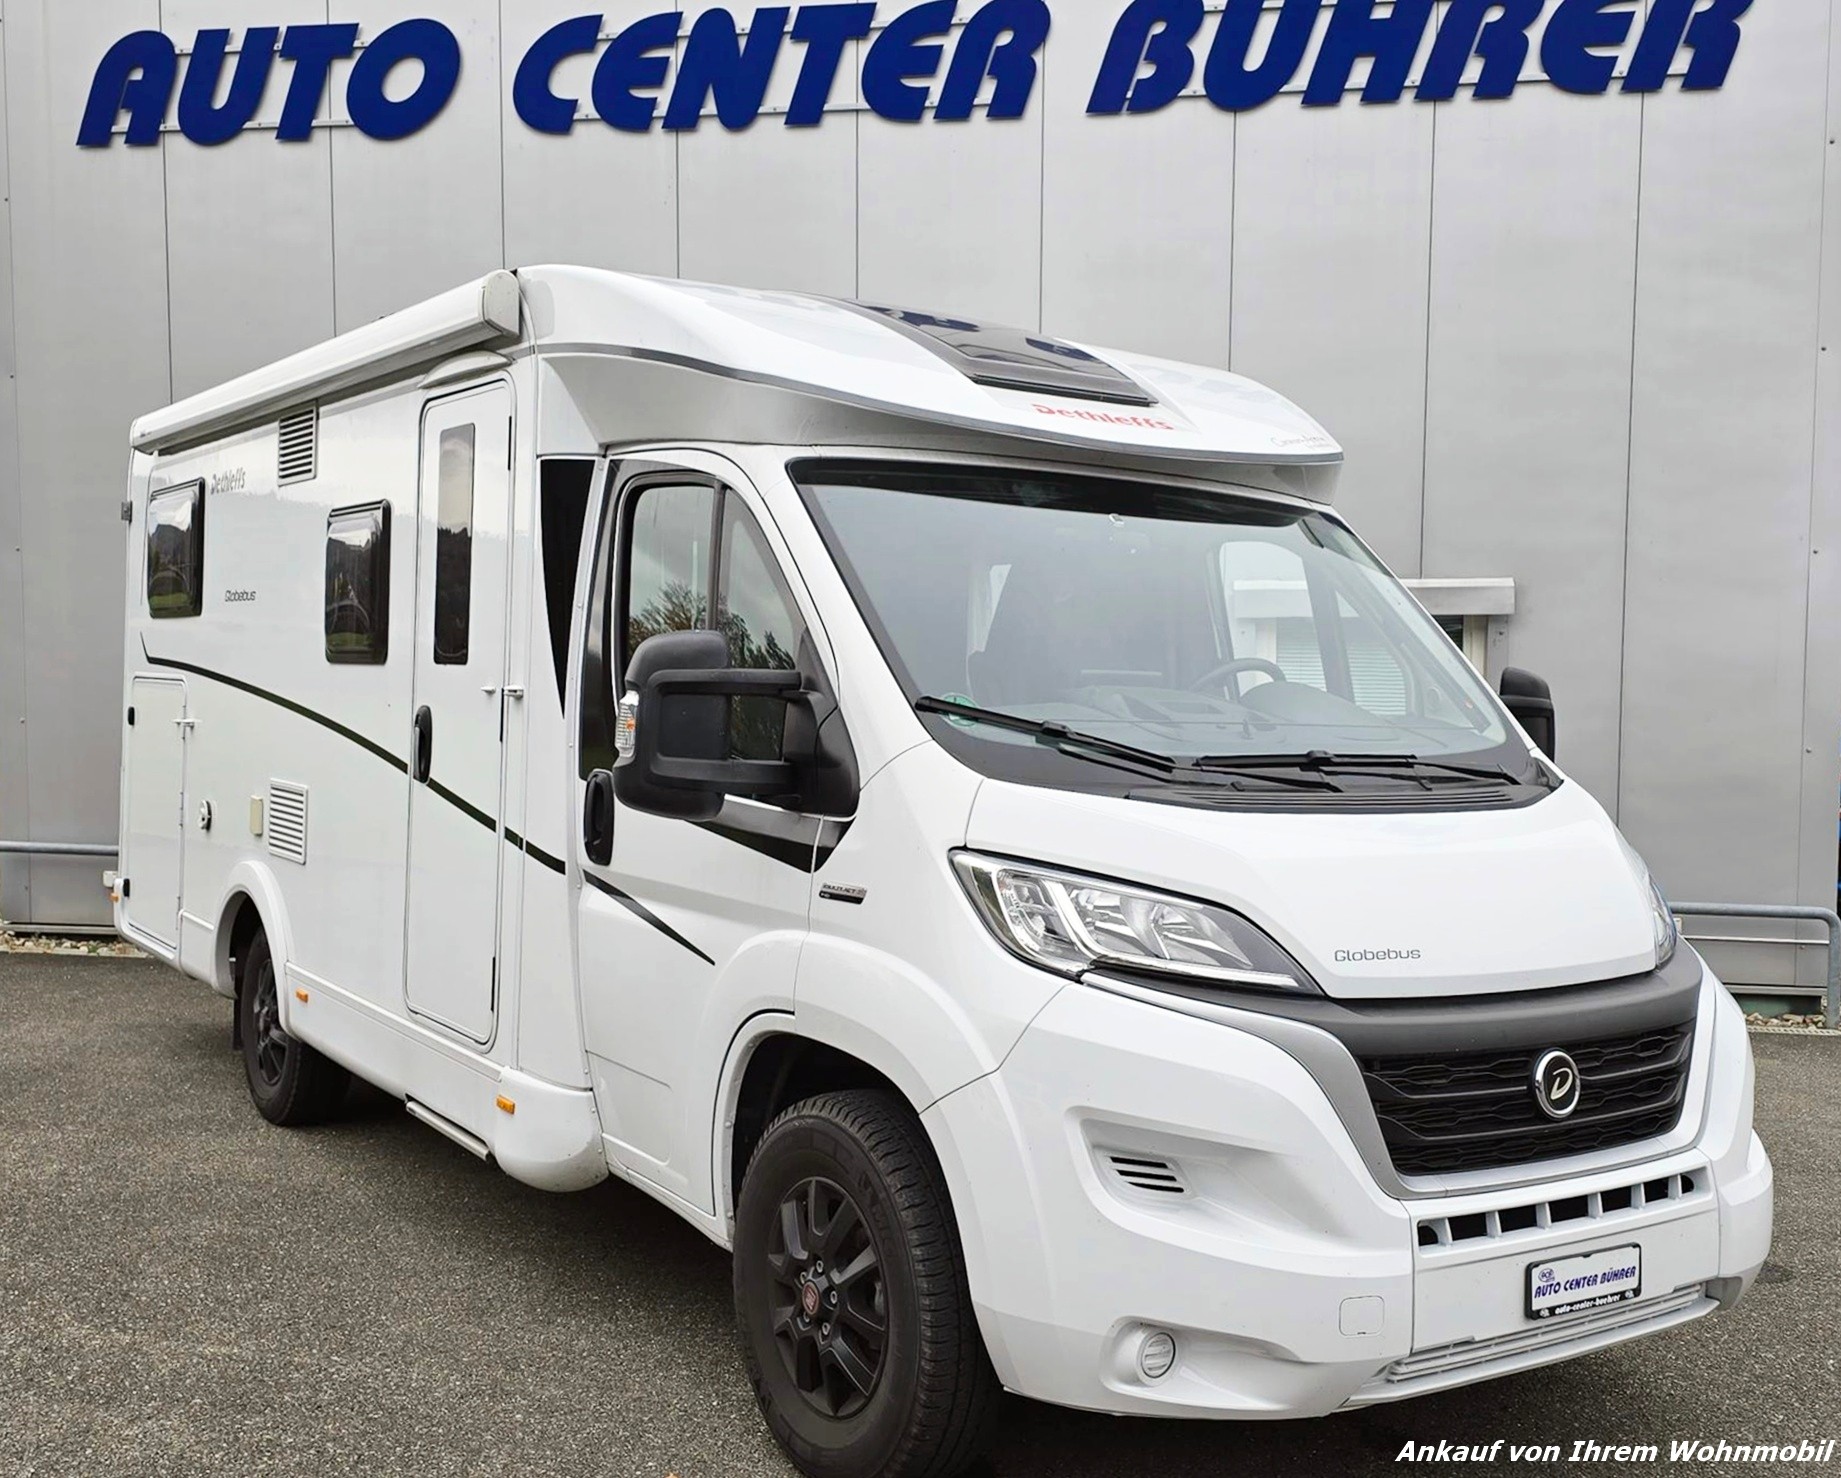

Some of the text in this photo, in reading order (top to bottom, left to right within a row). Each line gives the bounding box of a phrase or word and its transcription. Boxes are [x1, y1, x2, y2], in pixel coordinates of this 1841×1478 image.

[77, 18, 460, 146] AUTO
[513, 0, 1050, 133] CENTER
[1031, 402, 1175, 431] Dethleffs
[1334, 948, 1421, 962] Globebus
[1534, 1265, 1637, 1299] AUTO CENTER BÜHRER
